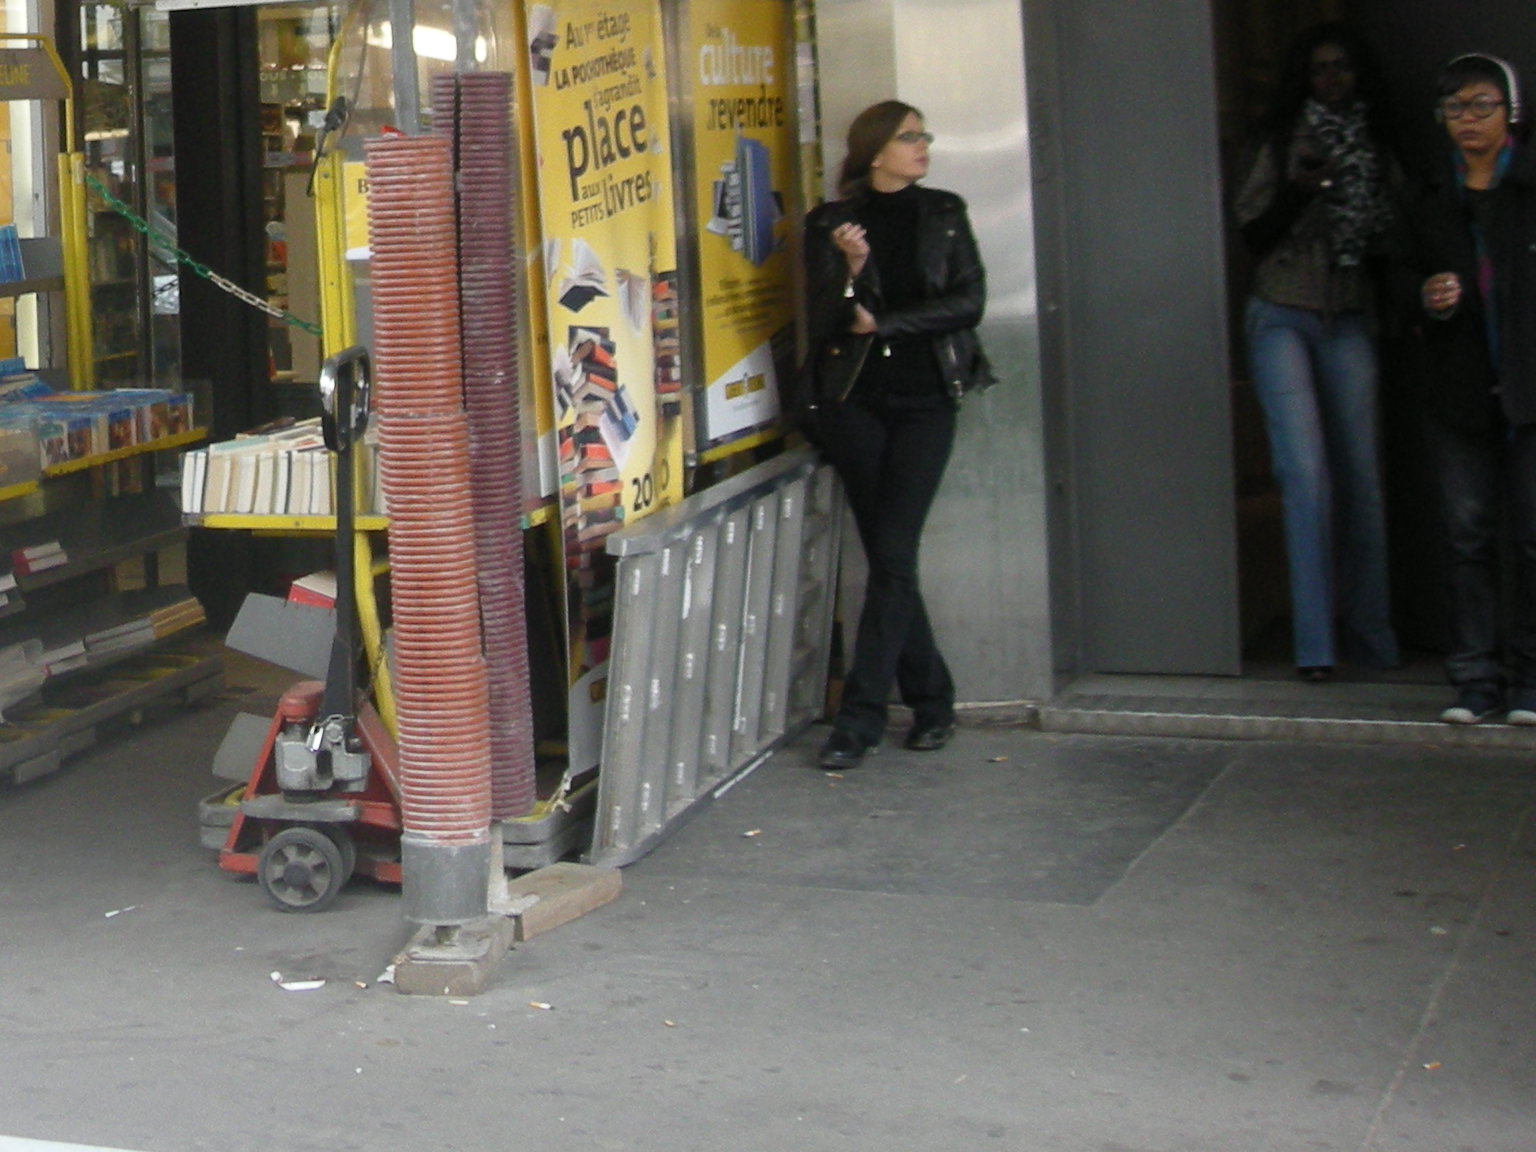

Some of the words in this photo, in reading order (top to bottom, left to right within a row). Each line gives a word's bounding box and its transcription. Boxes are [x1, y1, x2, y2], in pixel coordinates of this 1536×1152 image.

[699, 27, 775, 85] culture
[554, 67, 569, 90] LA
[561, 98, 648, 202] place
[570, 203, 604, 230] PETITS
